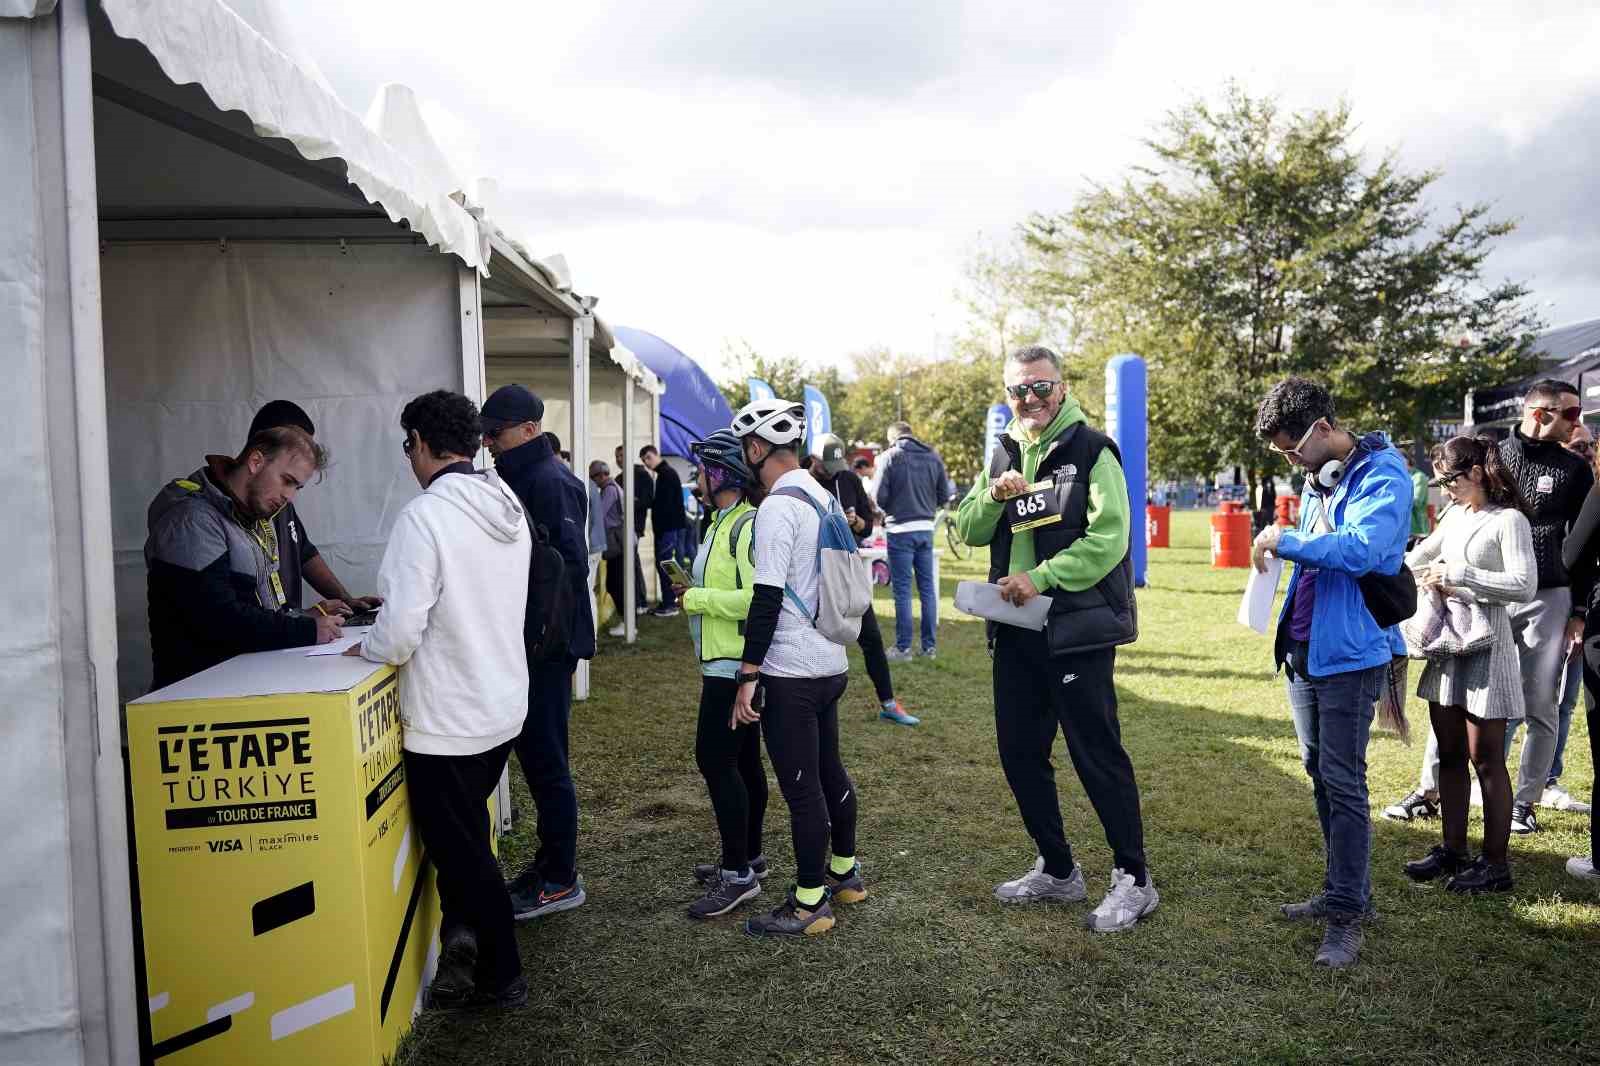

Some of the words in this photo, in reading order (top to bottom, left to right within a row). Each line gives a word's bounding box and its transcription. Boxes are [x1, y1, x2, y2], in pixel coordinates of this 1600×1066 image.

[1016, 494, 1046, 516] 865
[162, 771, 315, 803] TÜRKİYE
[216, 808, 248, 823] TOUR
[250, 806, 266, 820] DE
[267, 803, 312, 818] FRANCE
[206, 839, 243, 853] VISA
[258, 833, 319, 845] maximiles
